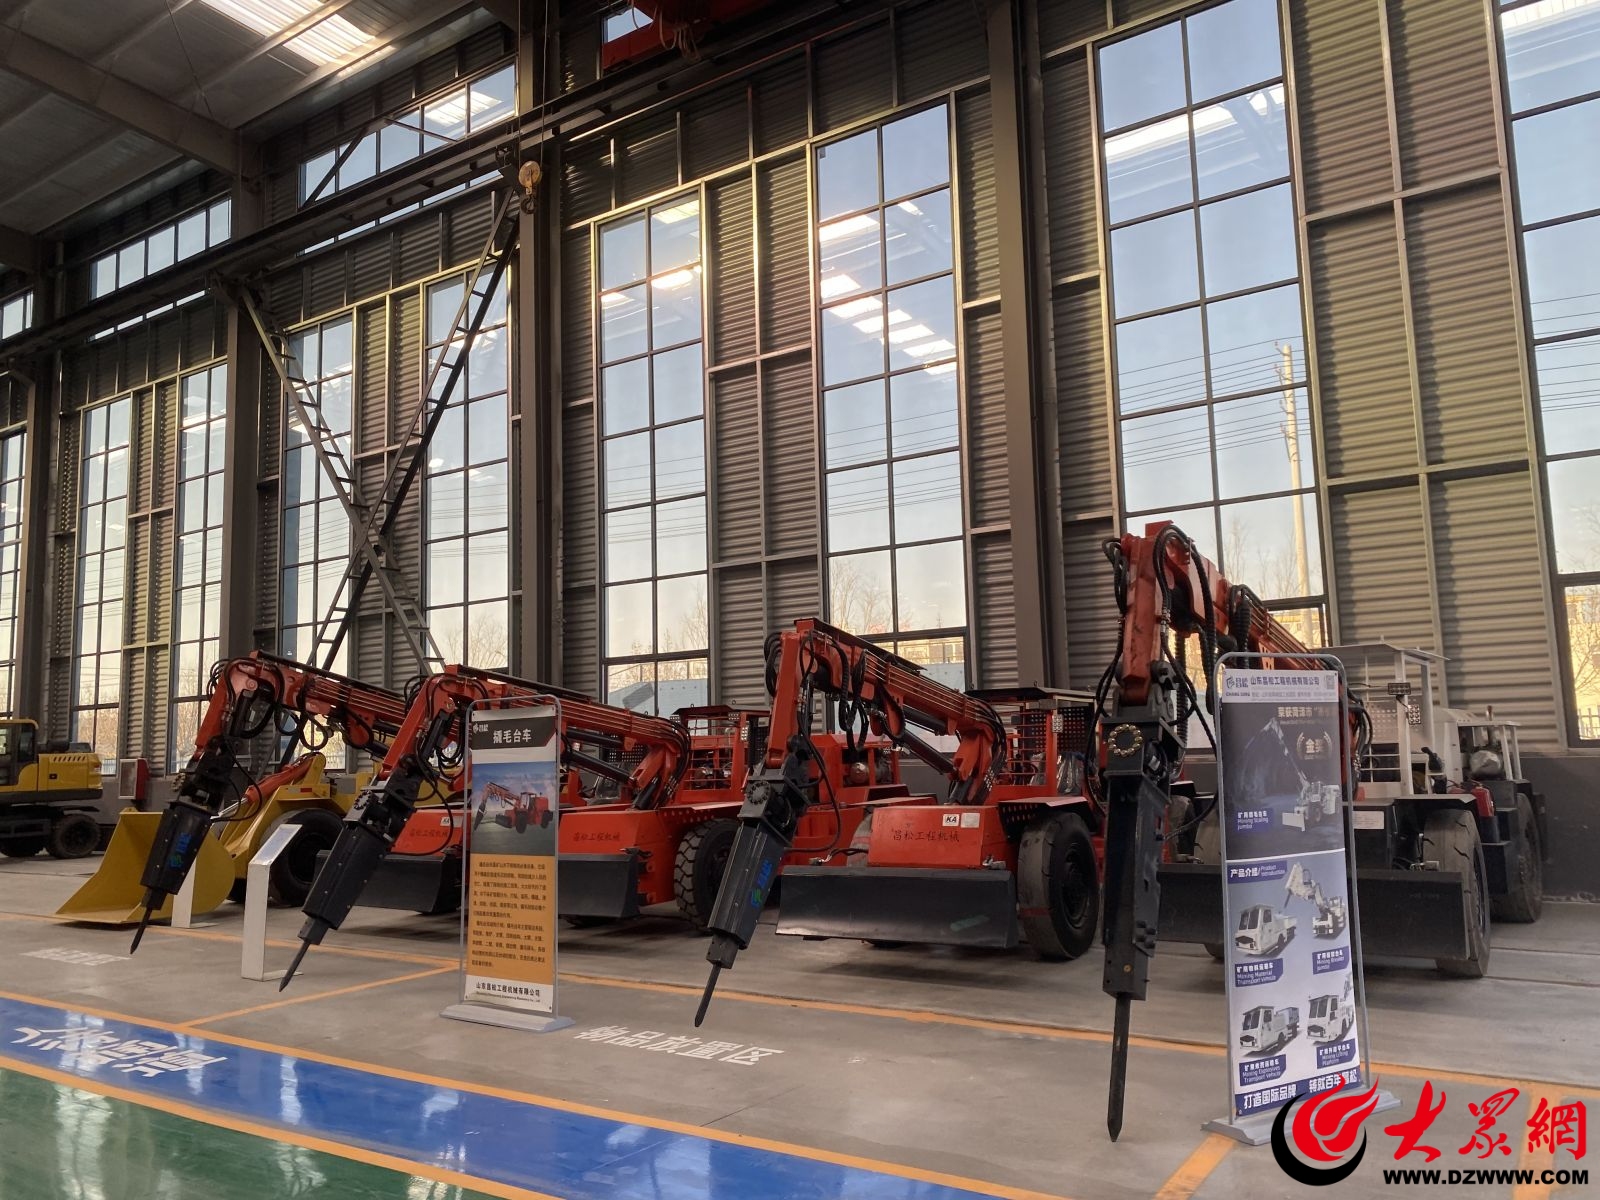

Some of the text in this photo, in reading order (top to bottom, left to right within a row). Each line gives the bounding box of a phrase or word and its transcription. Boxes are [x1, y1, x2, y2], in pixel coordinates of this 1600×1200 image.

[493, 728, 532, 744] 撬毛台车
[476, 982, 540, 997] 山东昌松工程机械有限公司
[573, 1025, 785, 1066] 物品放置区
[1244, 1083, 1297, 1109] 打造国际品牌
